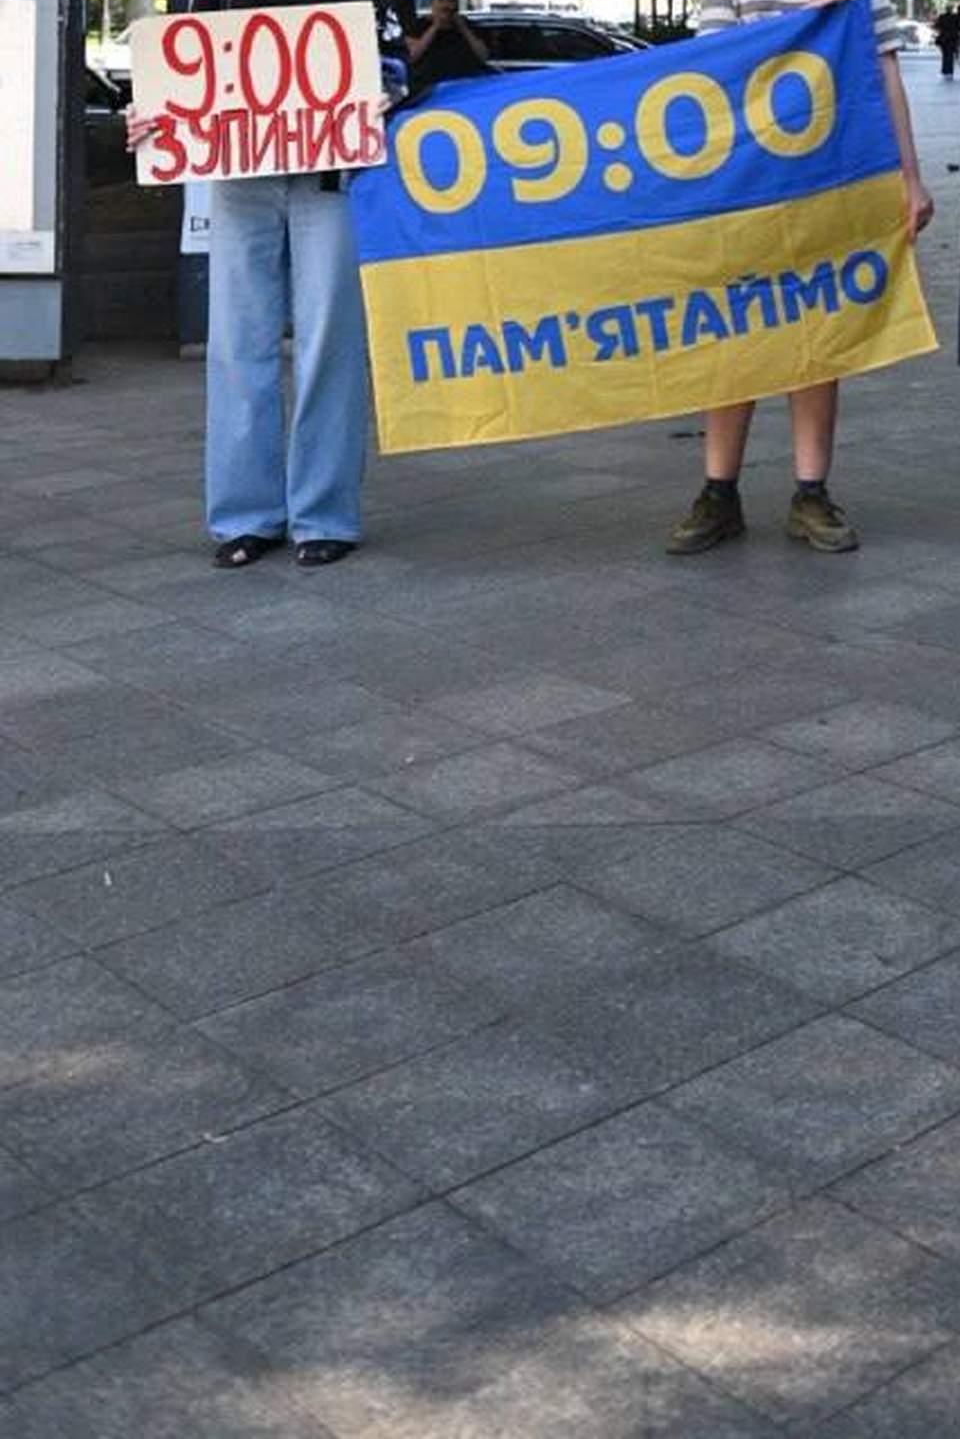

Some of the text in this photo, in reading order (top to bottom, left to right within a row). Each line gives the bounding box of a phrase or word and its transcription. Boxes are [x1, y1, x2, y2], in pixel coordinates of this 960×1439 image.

[161, 11, 353, 119] 9:00
[151, 101, 386, 182] ЗУПИНИСЬ
[395, 51, 836, 215] 09:00
[407, 250, 887, 384] ПАМ'ЯТАЙМО
